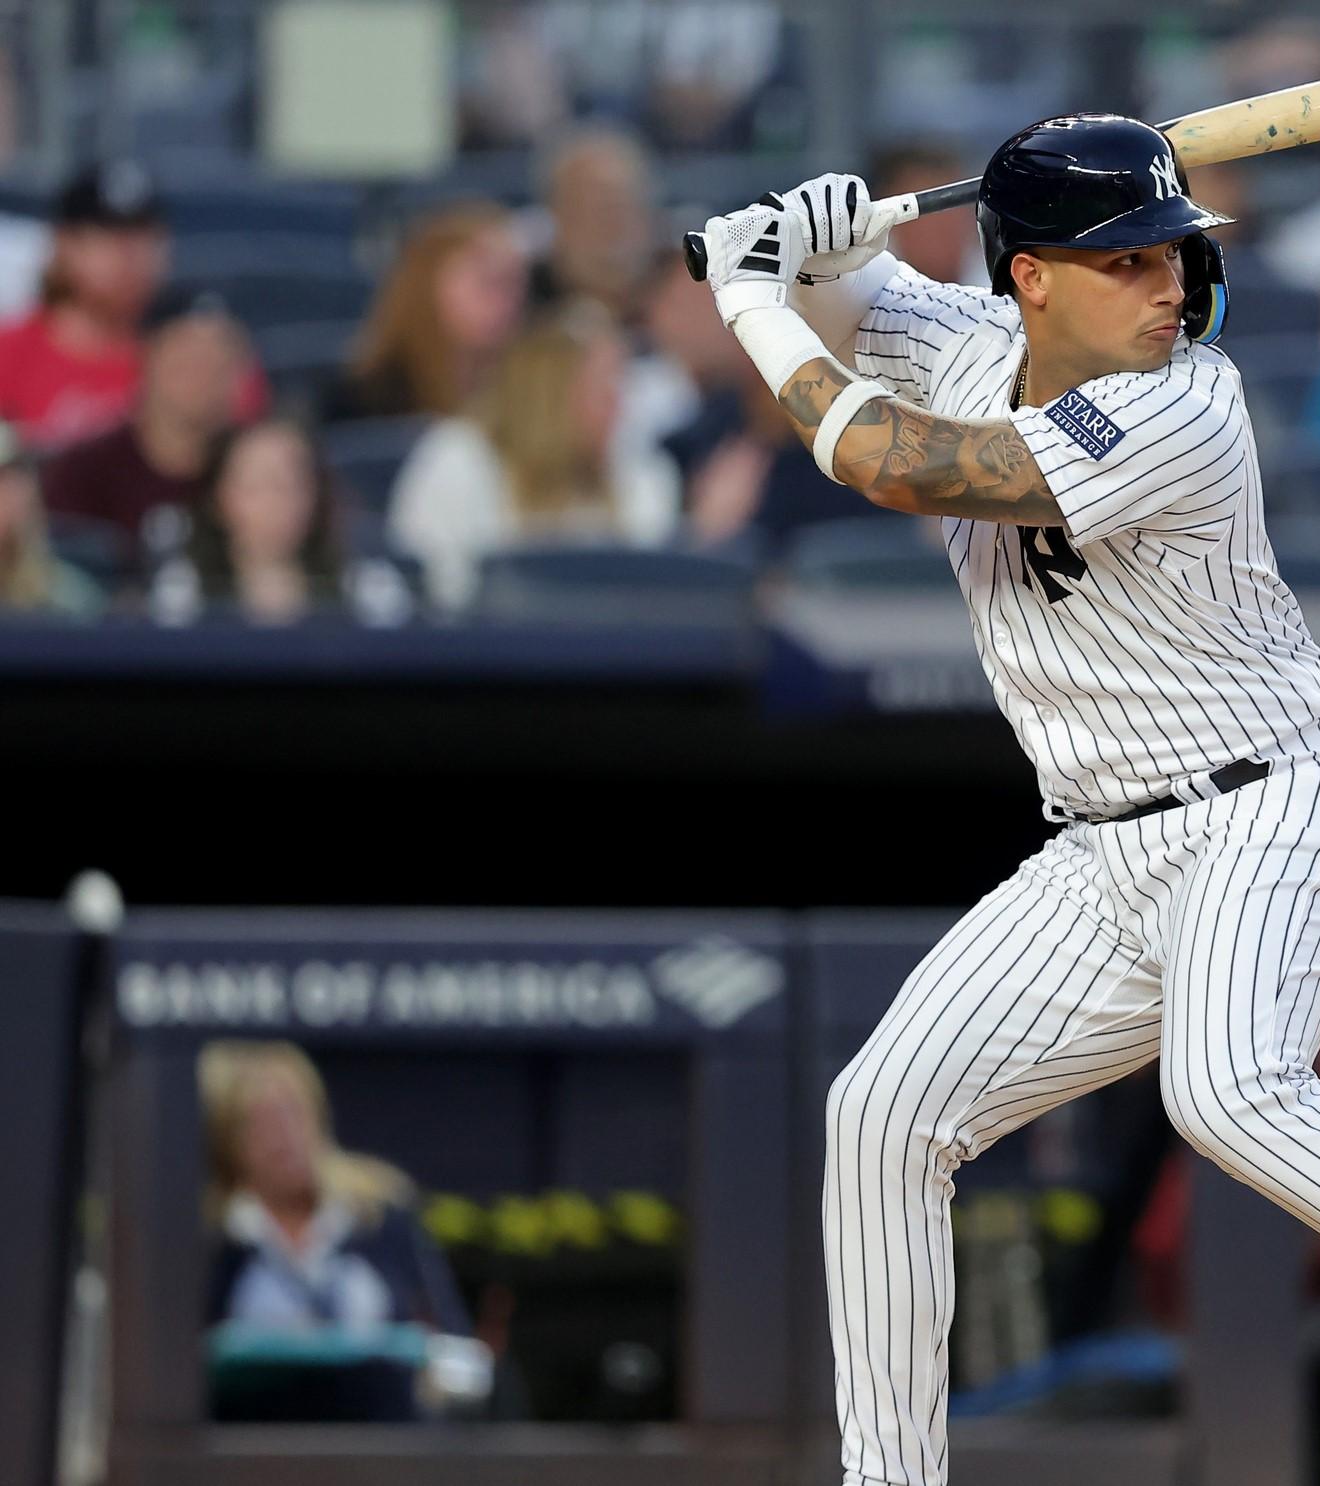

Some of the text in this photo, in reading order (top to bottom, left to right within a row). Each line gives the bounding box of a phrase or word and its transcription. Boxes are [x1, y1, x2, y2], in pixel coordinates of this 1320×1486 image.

[1049, 409, 1101, 456] INSURANCE
[1060, 393, 1117, 447] STARR
[117, 960, 657, 1028] BANK OF AMERICA
